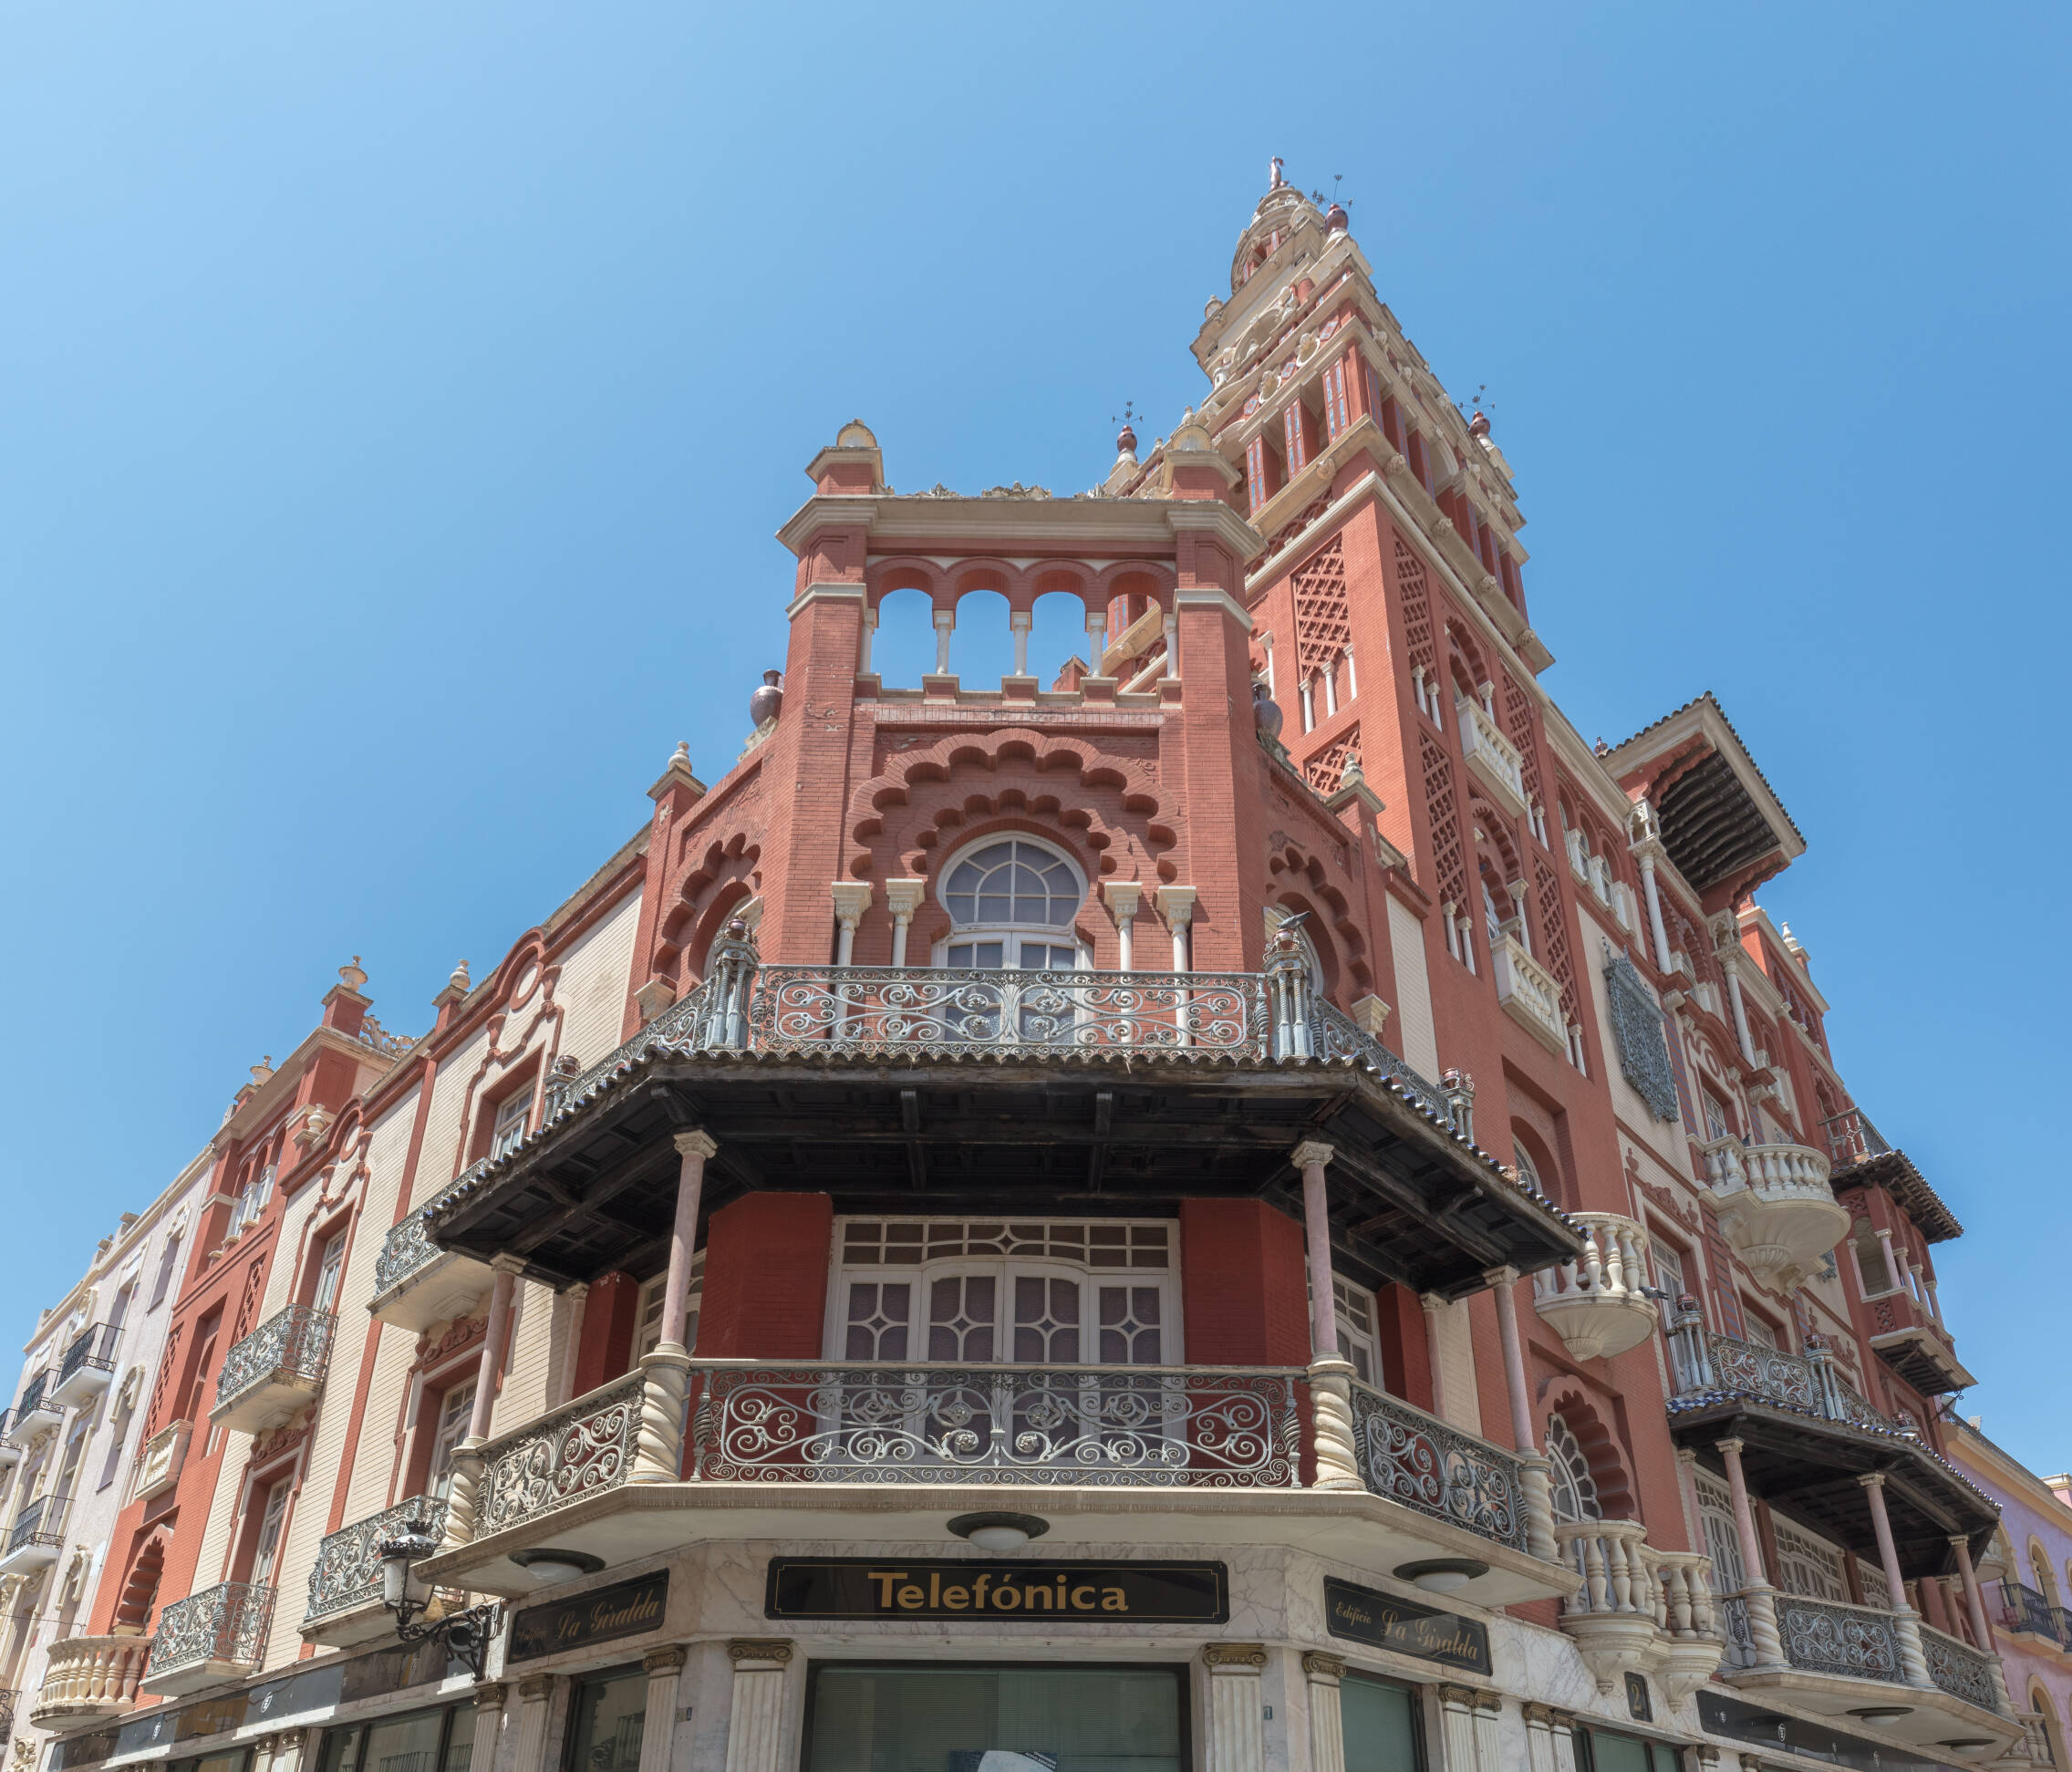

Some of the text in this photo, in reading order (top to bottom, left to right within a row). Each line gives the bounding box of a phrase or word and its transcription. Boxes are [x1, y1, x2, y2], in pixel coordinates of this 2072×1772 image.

[867, 1572, 1129, 1611] Telefónica
[555, 1611, 582, 1642] La
[591, 1590, 660, 1632] Giralda
[1335, 1601, 1477, 1661] Edificio La Giralda
[1631, 1684, 1642, 1712] 2
